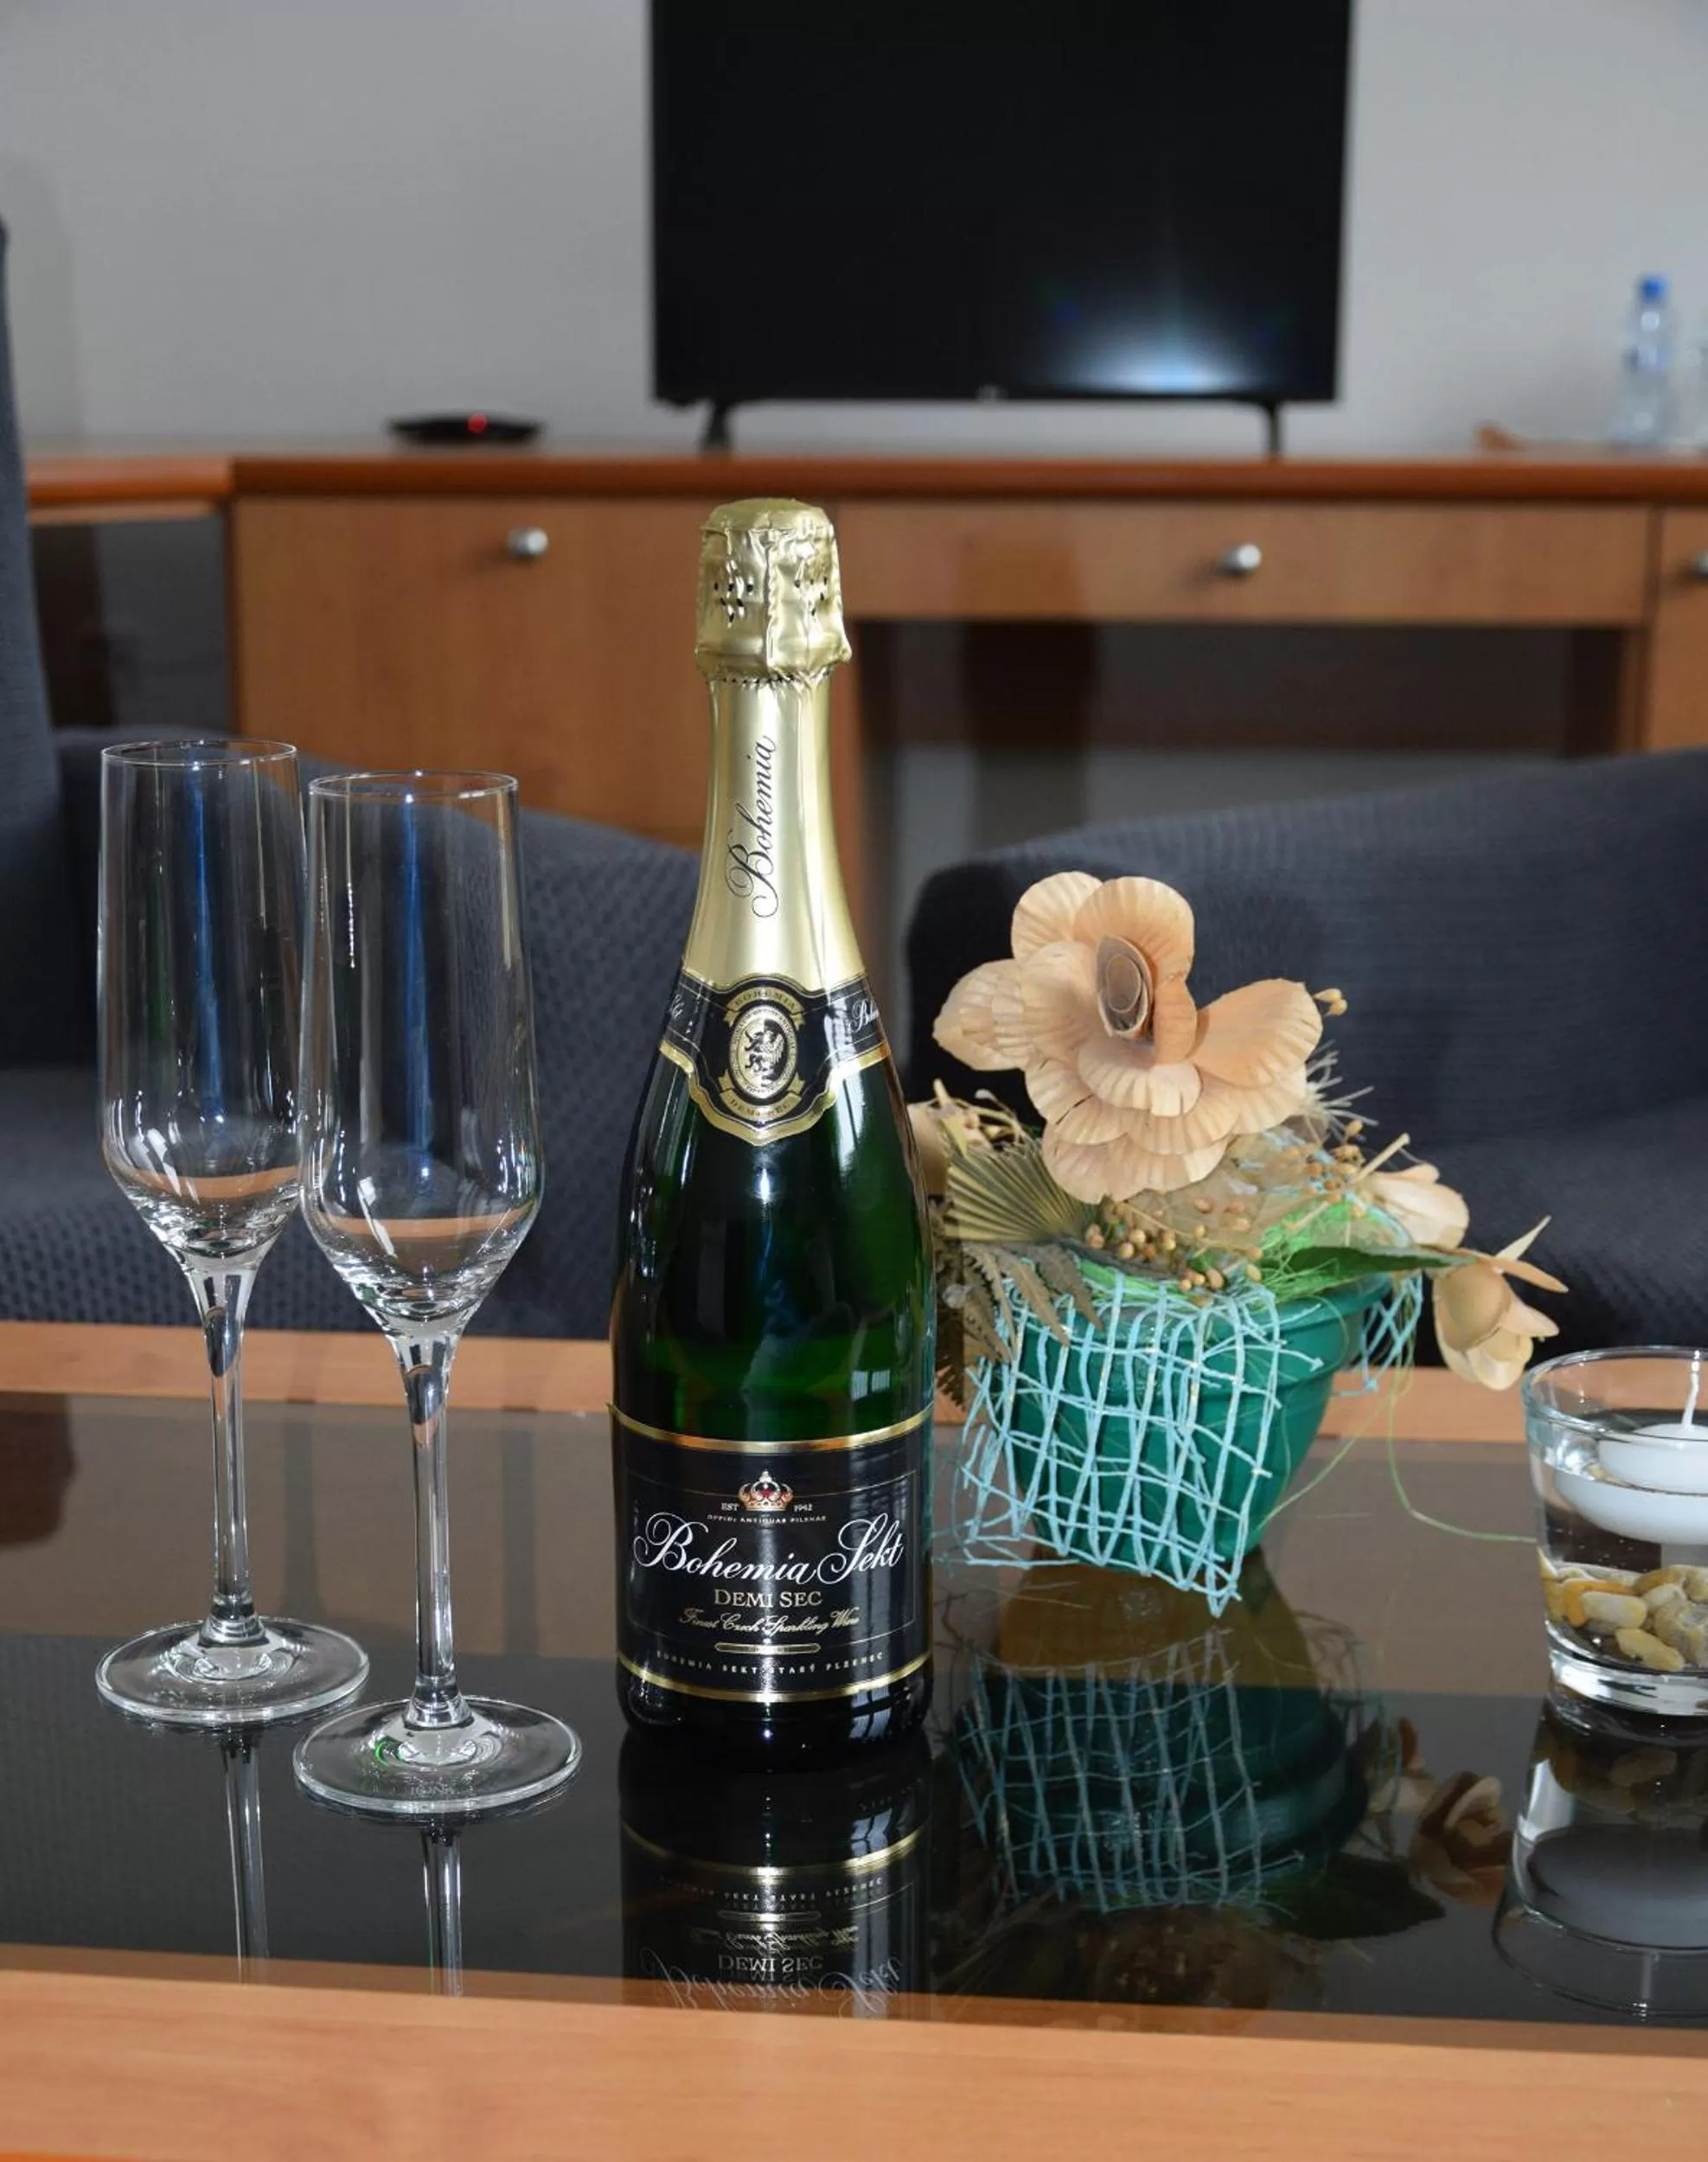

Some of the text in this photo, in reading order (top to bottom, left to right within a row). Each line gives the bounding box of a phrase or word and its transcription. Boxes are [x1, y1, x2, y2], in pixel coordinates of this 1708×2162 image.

[726, 735, 778, 918] Bohemia
[721, 1503, 739, 1512] EST
[633, 1512, 905, 1585] Bohemia Sekt
[714, 1589, 823, 1609] DEMI SEC
[761, 1615, 829, 1637] Sparkling
[829, 1606, 861, 1628] Wine
